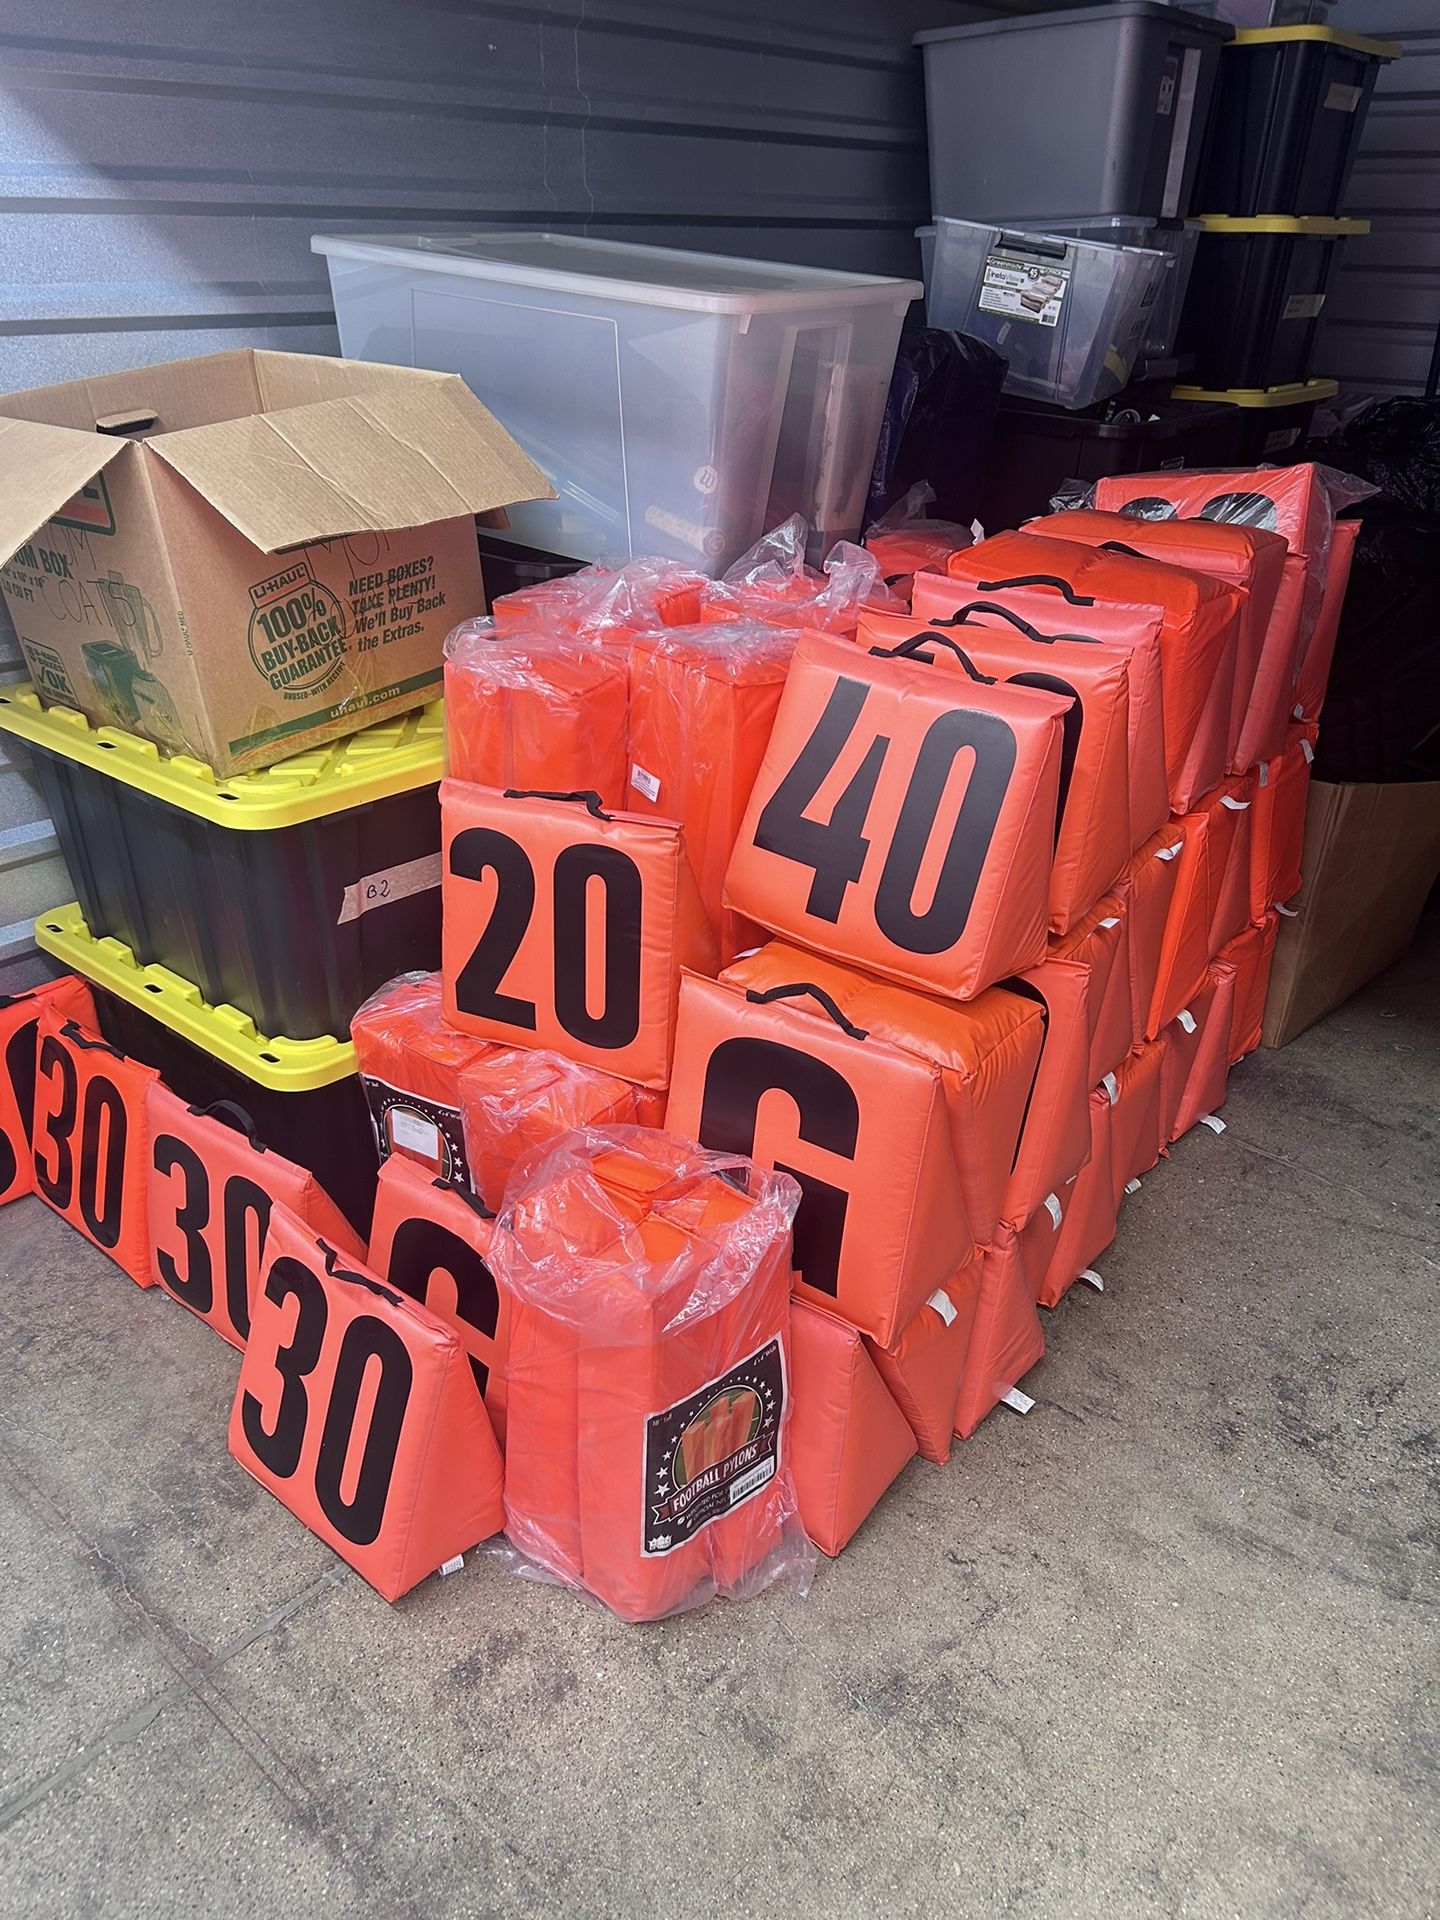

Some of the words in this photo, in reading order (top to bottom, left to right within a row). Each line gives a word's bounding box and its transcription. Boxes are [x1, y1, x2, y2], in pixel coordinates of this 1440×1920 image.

[14, 544, 39, 570] UM
[39, 548, 74, 580] BOX
[253, 567, 306, 599] U-HAUL
[349, 573, 384, 596] NEED
[387, 556, 434, 585] BOXES?
[41, 575, 136, 627] COATS
[257, 588, 327, 643] 100%
[352, 592, 384, 616] TAKE
[388, 575, 436, 604] PLENTY!
[355, 612, 386, 634] We'll
[390, 603, 413, 626] Buy
[417, 592, 446, 613] Back
[261, 616, 341, 672] BUY-BACK
[358, 635, 379, 652] the
[383, 621, 424, 644] Extras.
[45, 670, 74, 695] OK
[330, 687, 400, 718] uhaul.com
[752, 675, 1018, 955] 40
[449, 827, 643, 1050] 20
[34, 1034, 127, 1249] 30
[153, 1133, 275, 1340] 30
[242, 1256, 415, 1547] 30
[673, 1468, 721, 1512] FOOTBALL
[723, 1443, 758, 1478] PYLONS
